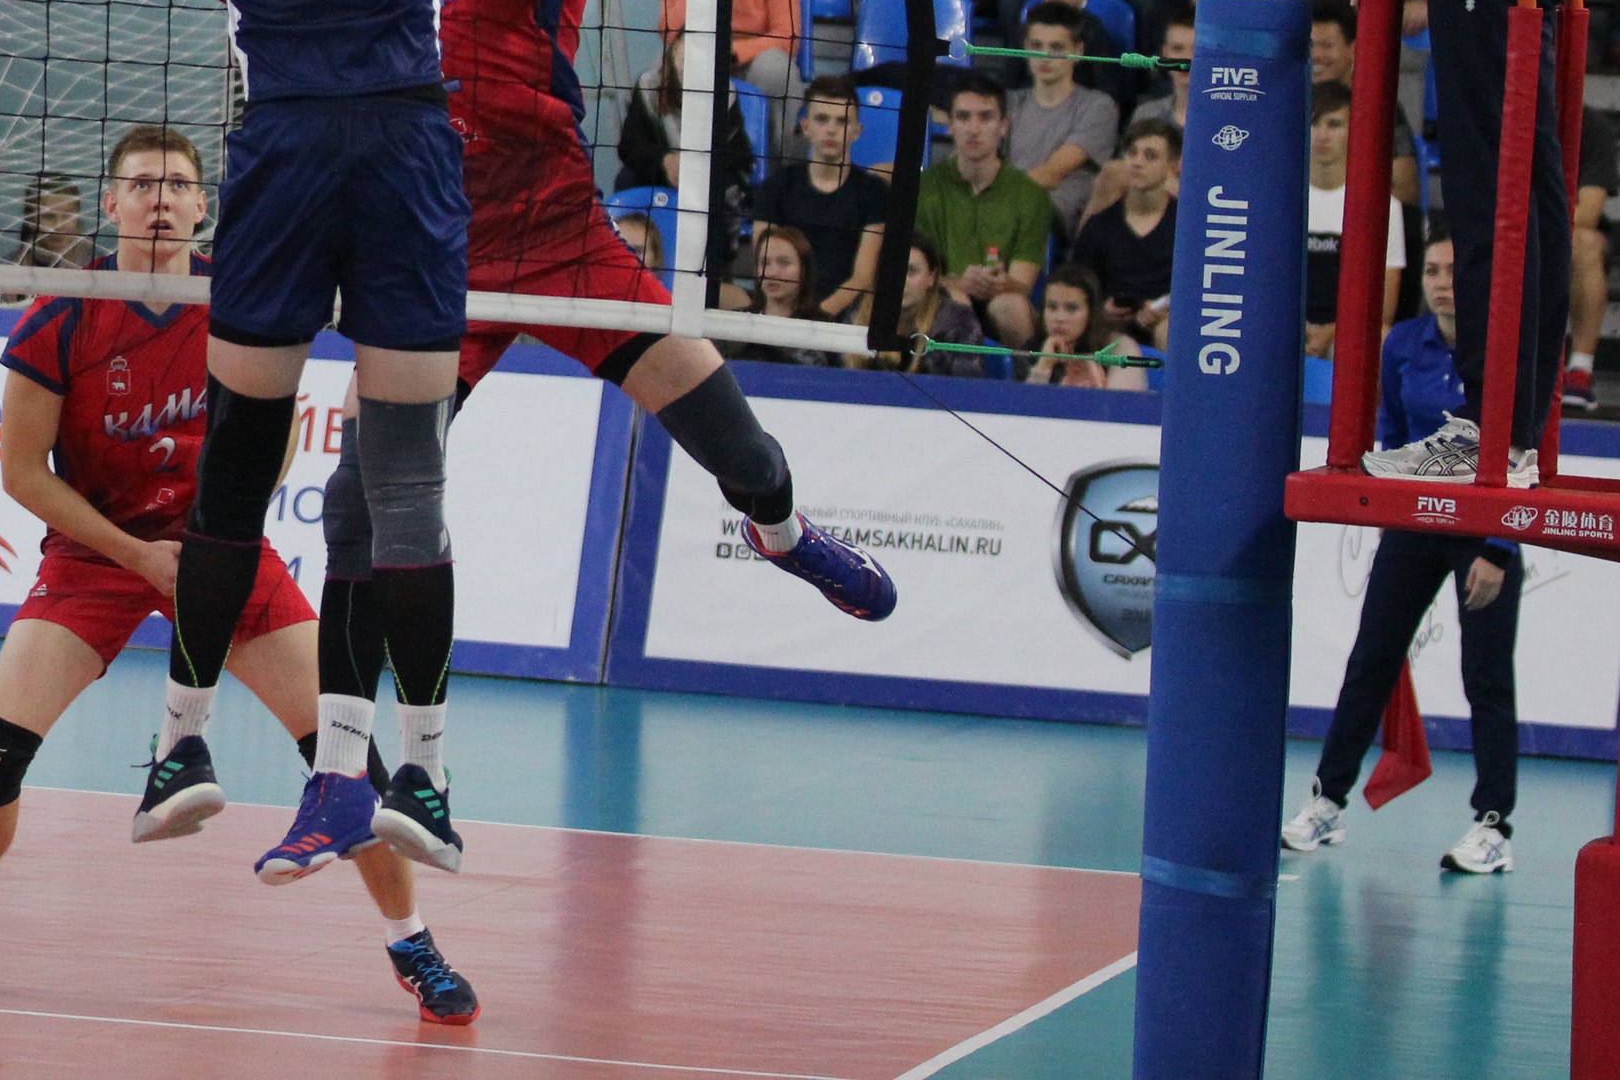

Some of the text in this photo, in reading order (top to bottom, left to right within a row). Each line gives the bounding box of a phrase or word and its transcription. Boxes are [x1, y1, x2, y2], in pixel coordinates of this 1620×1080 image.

[1211, 67, 1260, 86] FIVB
[1198, 185, 1249, 376] JINLING
[149, 436, 183, 473] 2
[1417, 495, 1456, 513] FIVB
[1542, 526, 1616, 540] JINLING SPORTS
